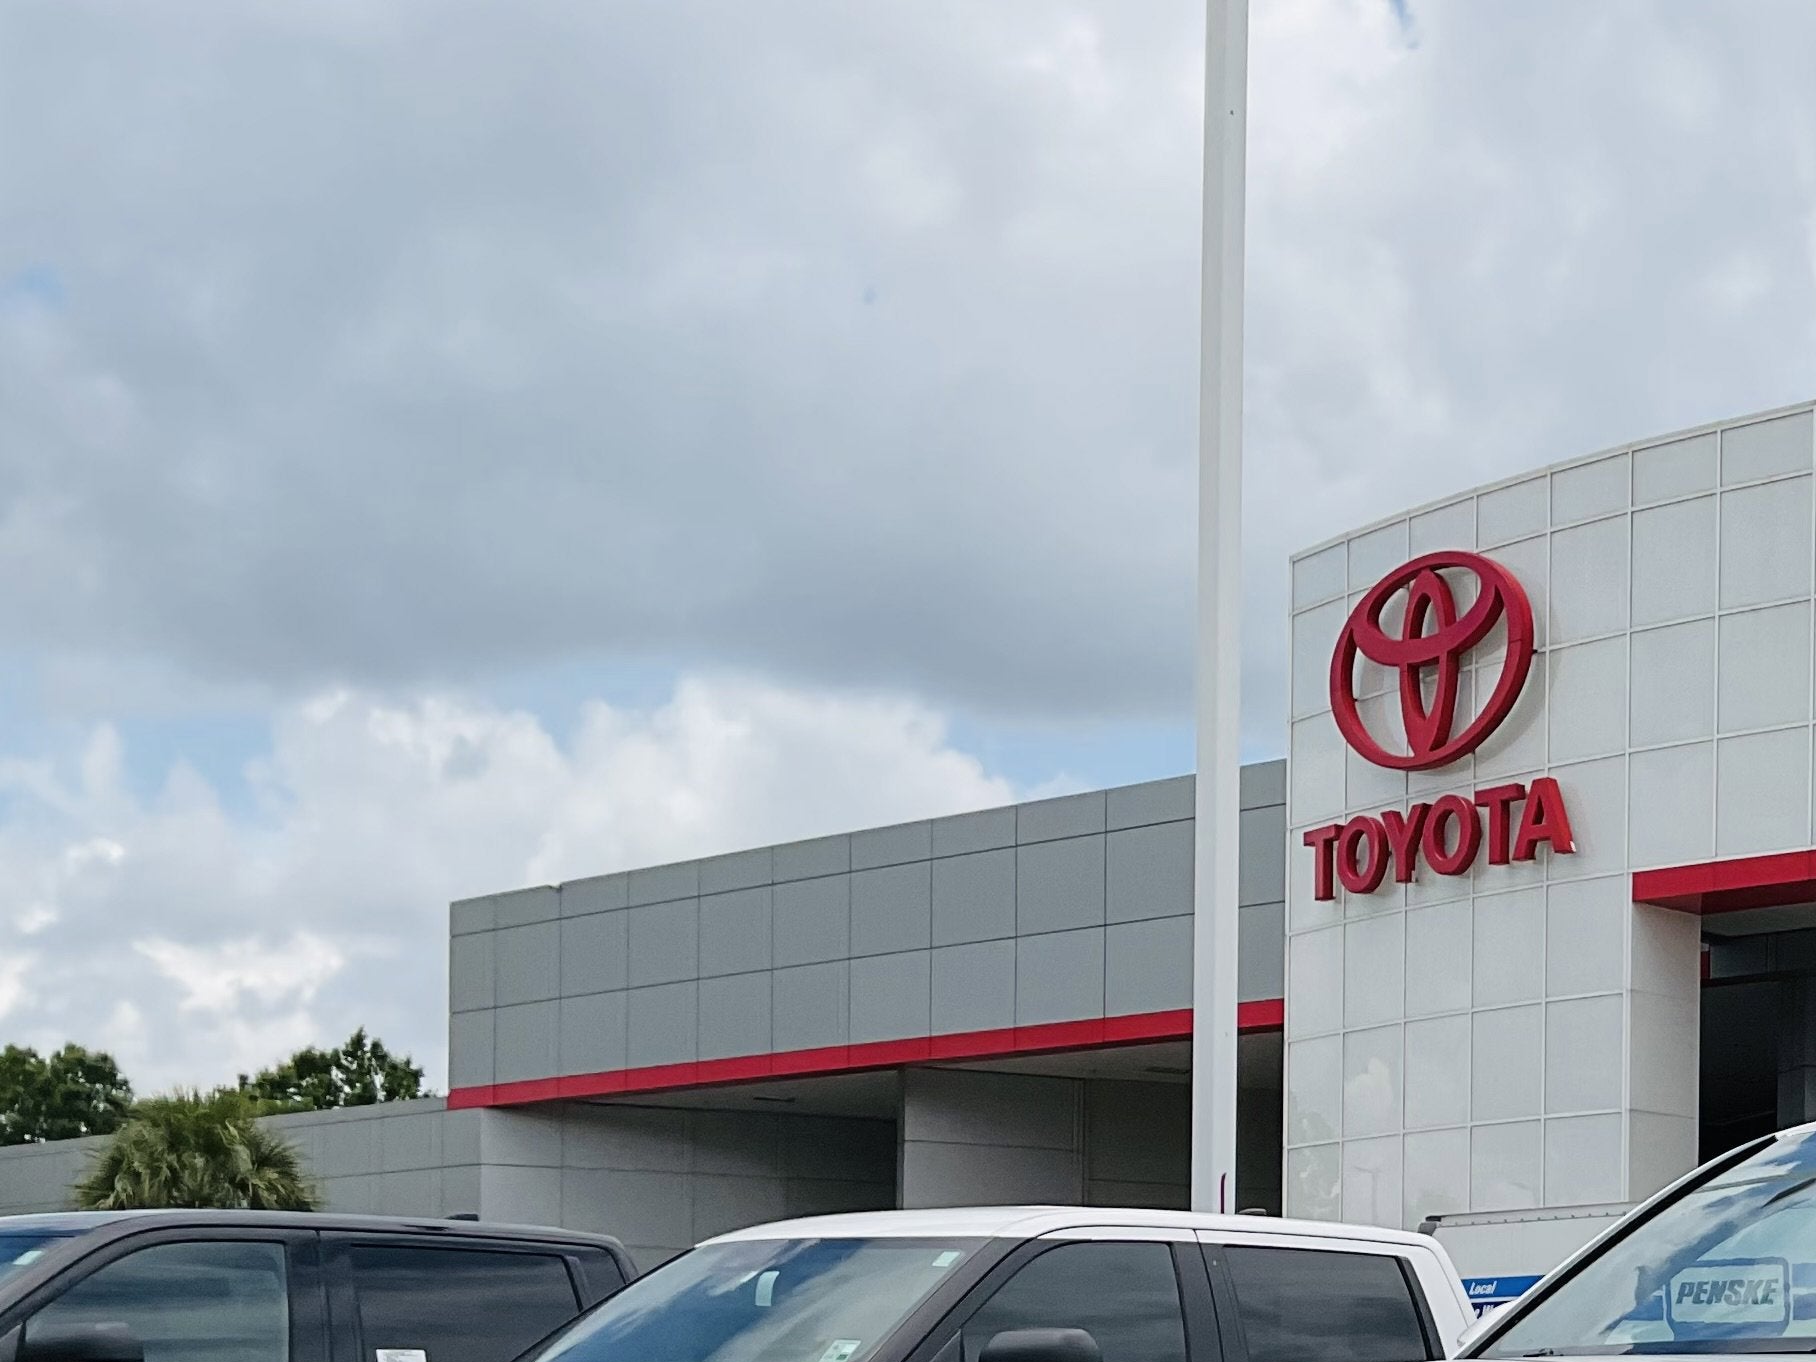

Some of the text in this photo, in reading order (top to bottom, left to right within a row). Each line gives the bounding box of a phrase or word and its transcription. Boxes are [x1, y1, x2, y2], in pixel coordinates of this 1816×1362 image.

[1303, 777, 1575, 901] TOYOTA
[1469, 1281, 1497, 1295] Local
[1675, 1279, 1779, 1305] PENSKE
